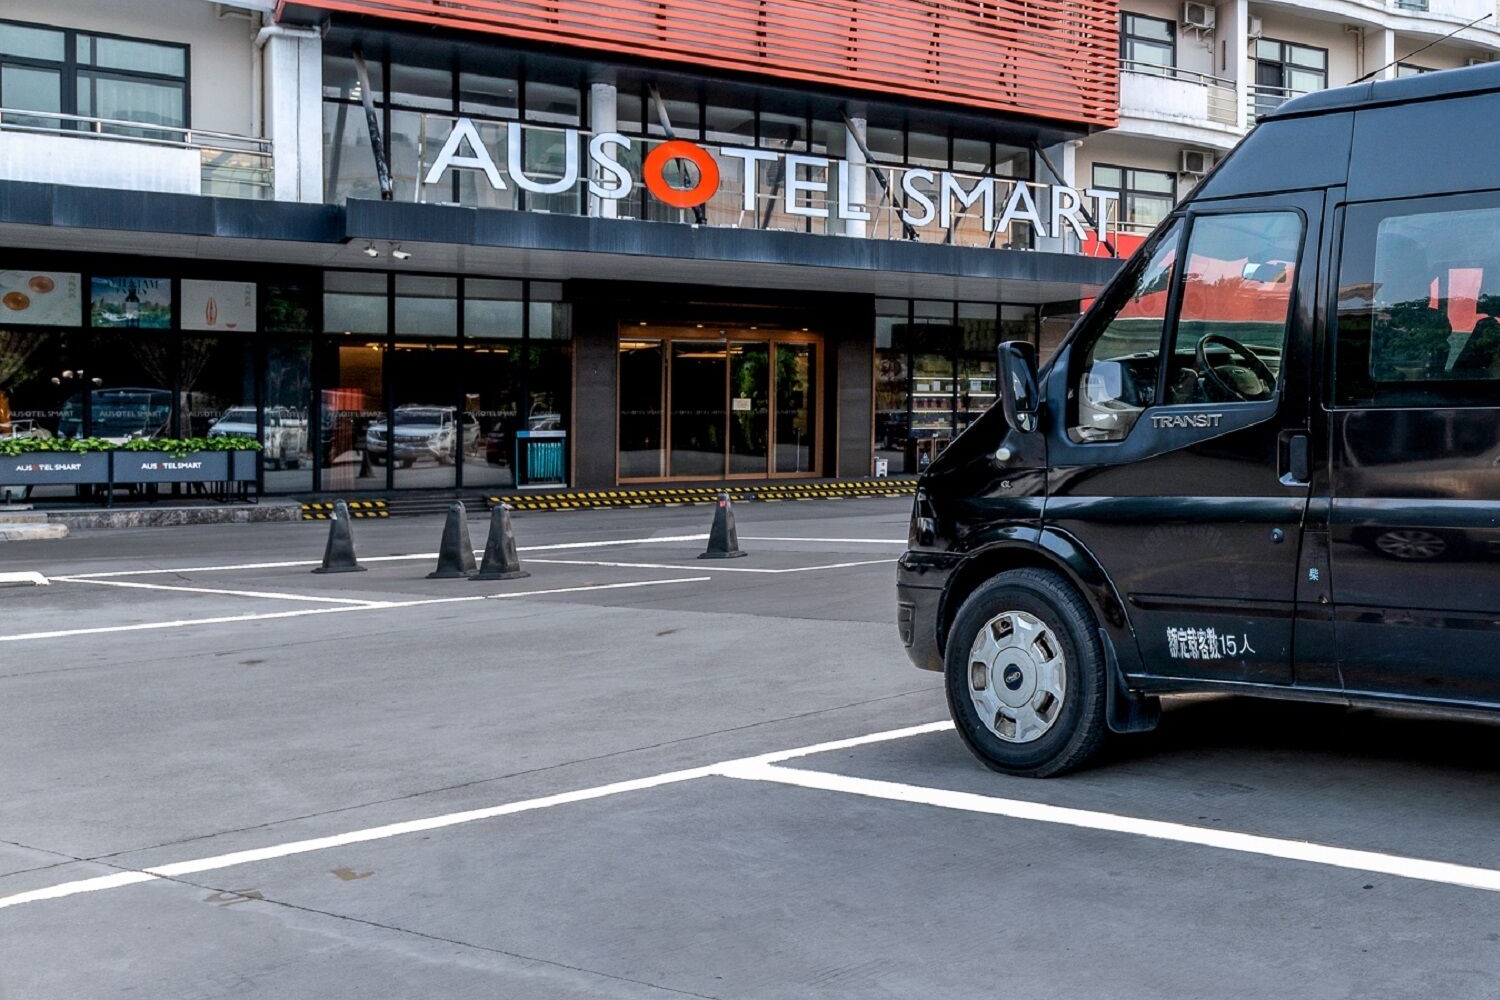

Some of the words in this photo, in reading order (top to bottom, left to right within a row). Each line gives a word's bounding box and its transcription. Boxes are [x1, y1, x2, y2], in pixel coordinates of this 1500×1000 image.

[425, 117, 871, 222] AUSOTEL
[901, 167, 1119, 243] SMART
[1151, 413, 1223, 429] TRANSIT
